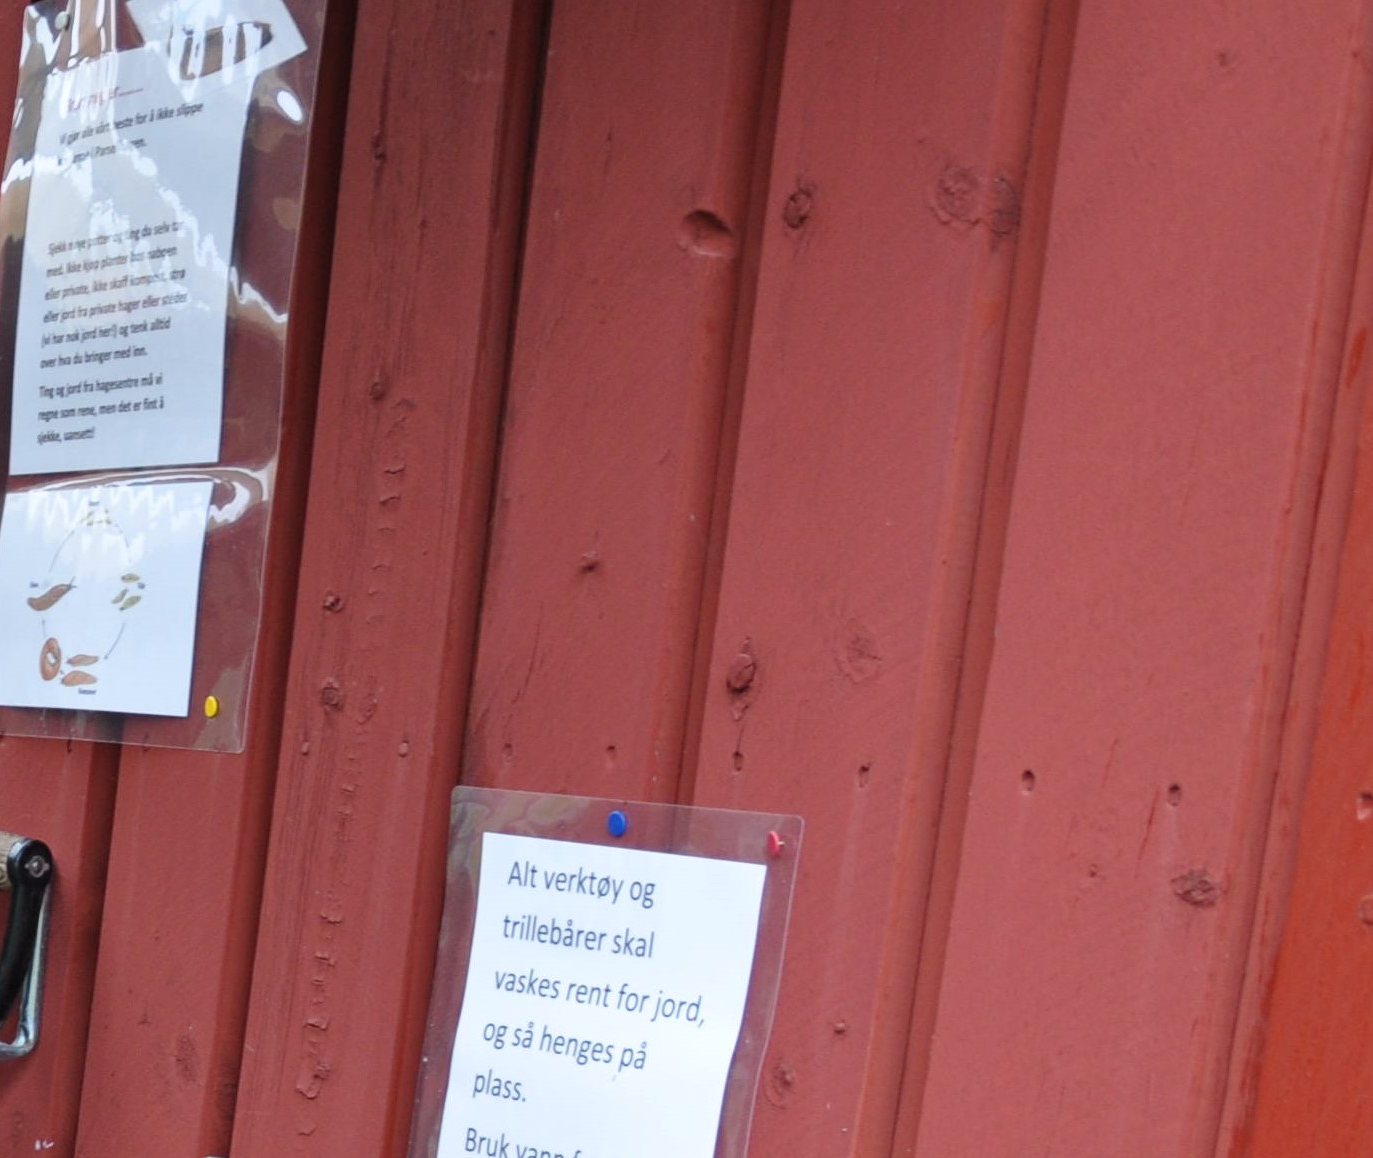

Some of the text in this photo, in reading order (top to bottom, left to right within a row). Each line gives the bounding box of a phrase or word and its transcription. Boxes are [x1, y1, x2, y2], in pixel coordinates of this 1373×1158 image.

[507, 860, 656, 910] Alt verktøy og
[503, 914, 655, 959] trillebårer skal
[495, 968, 704, 1027] vaskes rent for jord,
[483, 1021, 647, 1072] og så henges på
[472, 1069, 526, 1103] plass.
